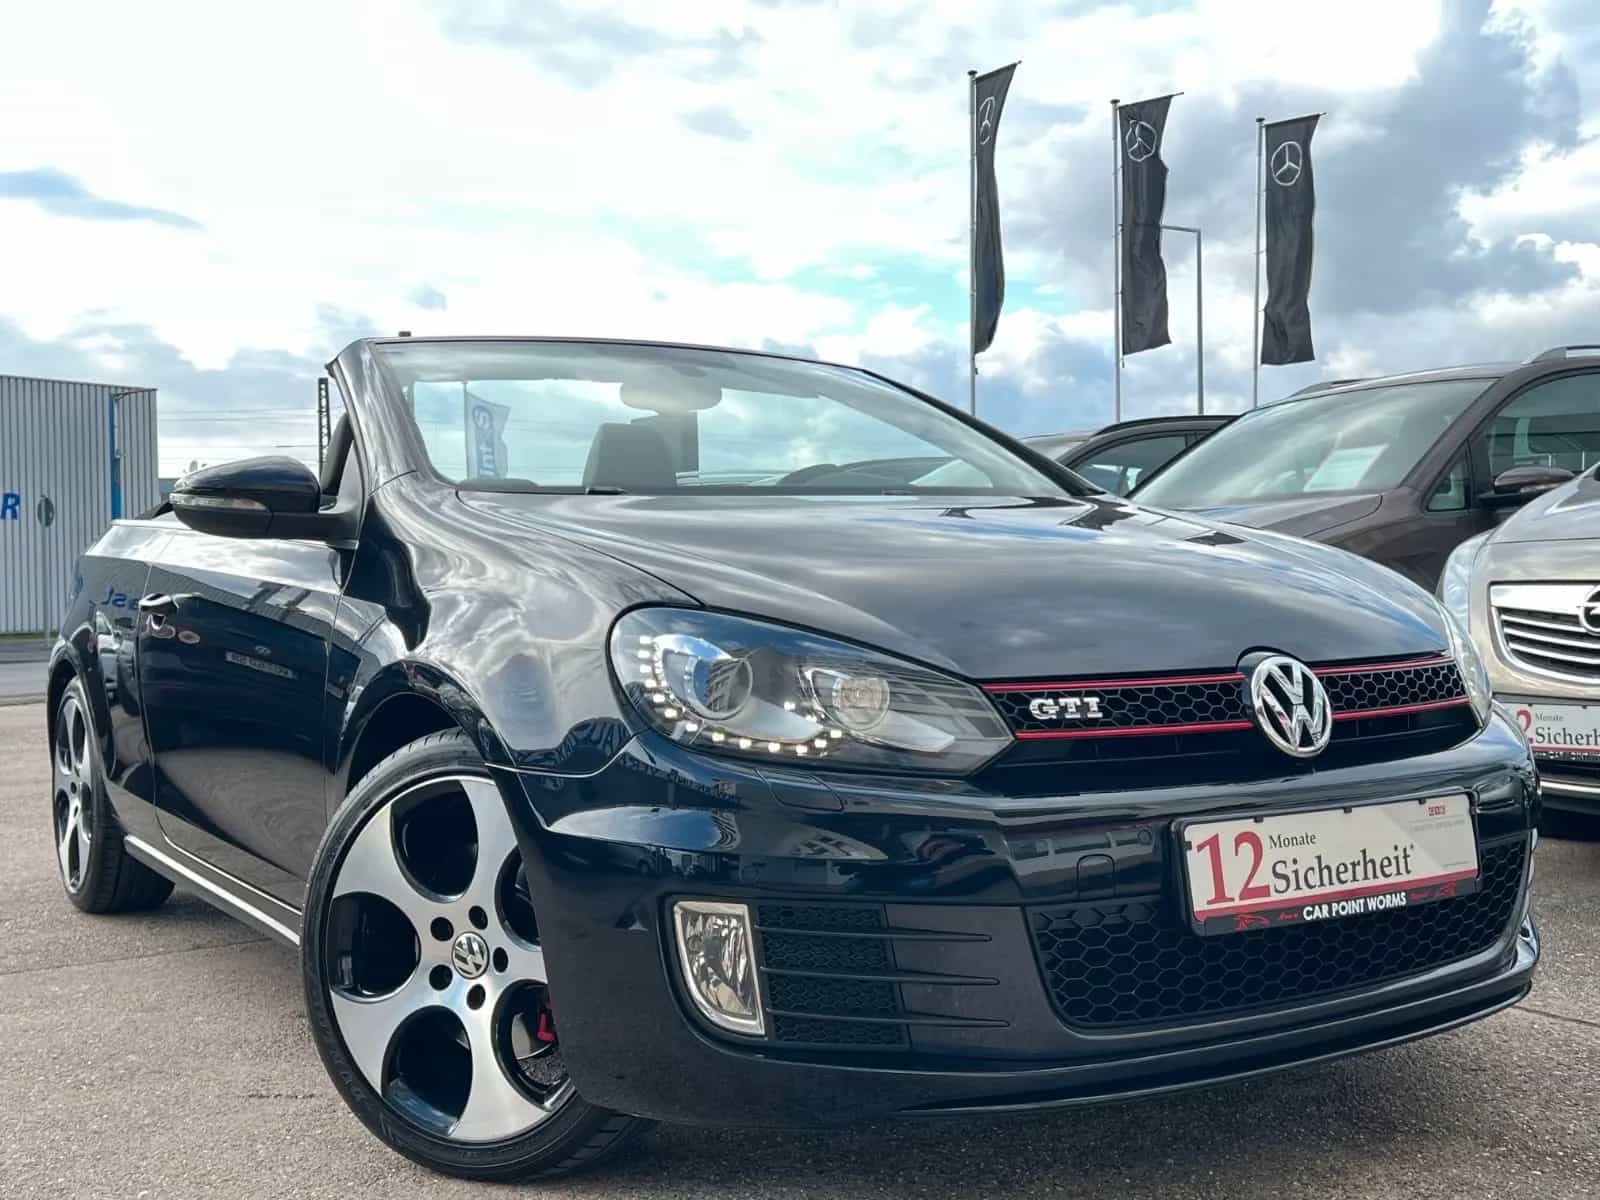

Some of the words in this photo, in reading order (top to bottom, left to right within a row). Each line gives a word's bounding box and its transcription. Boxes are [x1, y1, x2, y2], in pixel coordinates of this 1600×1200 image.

[1029, 697, 1103, 720] GTI
[1195, 831, 1272, 905] 12
[1269, 831, 1317, 849] Monate
[1271, 845, 1412, 894] Sicherheit
[1303, 904, 1329, 921] CAR
[1332, 898, 1365, 916] POINT
[1366, 891, 1408, 909] WORMS
